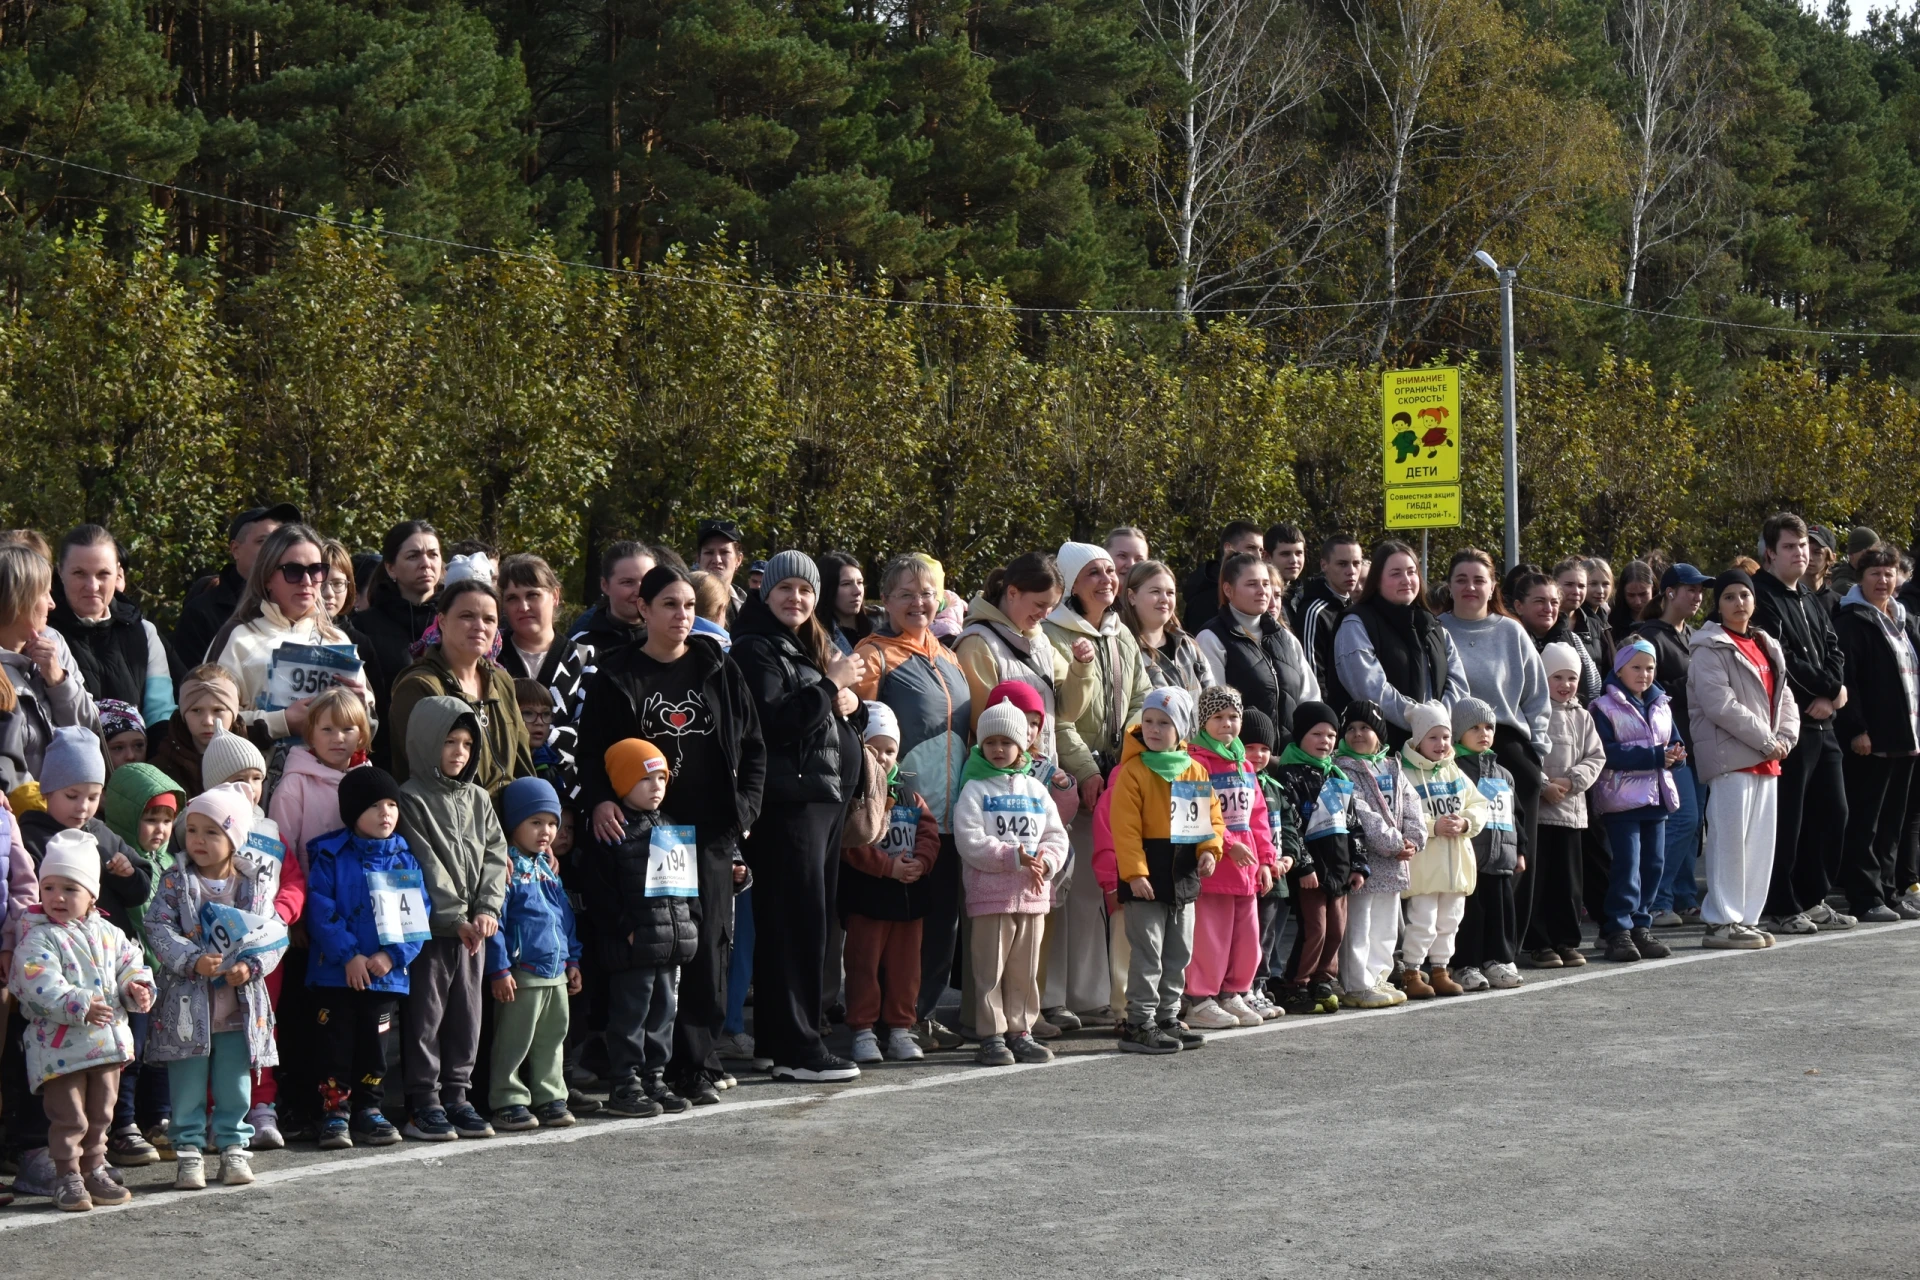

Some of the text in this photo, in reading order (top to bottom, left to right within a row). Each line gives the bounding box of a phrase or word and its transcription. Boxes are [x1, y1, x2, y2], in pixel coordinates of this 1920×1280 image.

[1396, 374, 1446, 385] ВНИМАНИЕ!
[1394, 384, 1447, 395] ОГРАНИЧЬТЕ
[1398, 395, 1445, 405] СКОРОСТЬ!
[1406, 466, 1438, 479] ДЕТИ
[1390, 491, 1455, 501] Совместная акция
[1406, 502, 1432, 510] ГИБДД
[996, 815, 1038, 837] 9429
